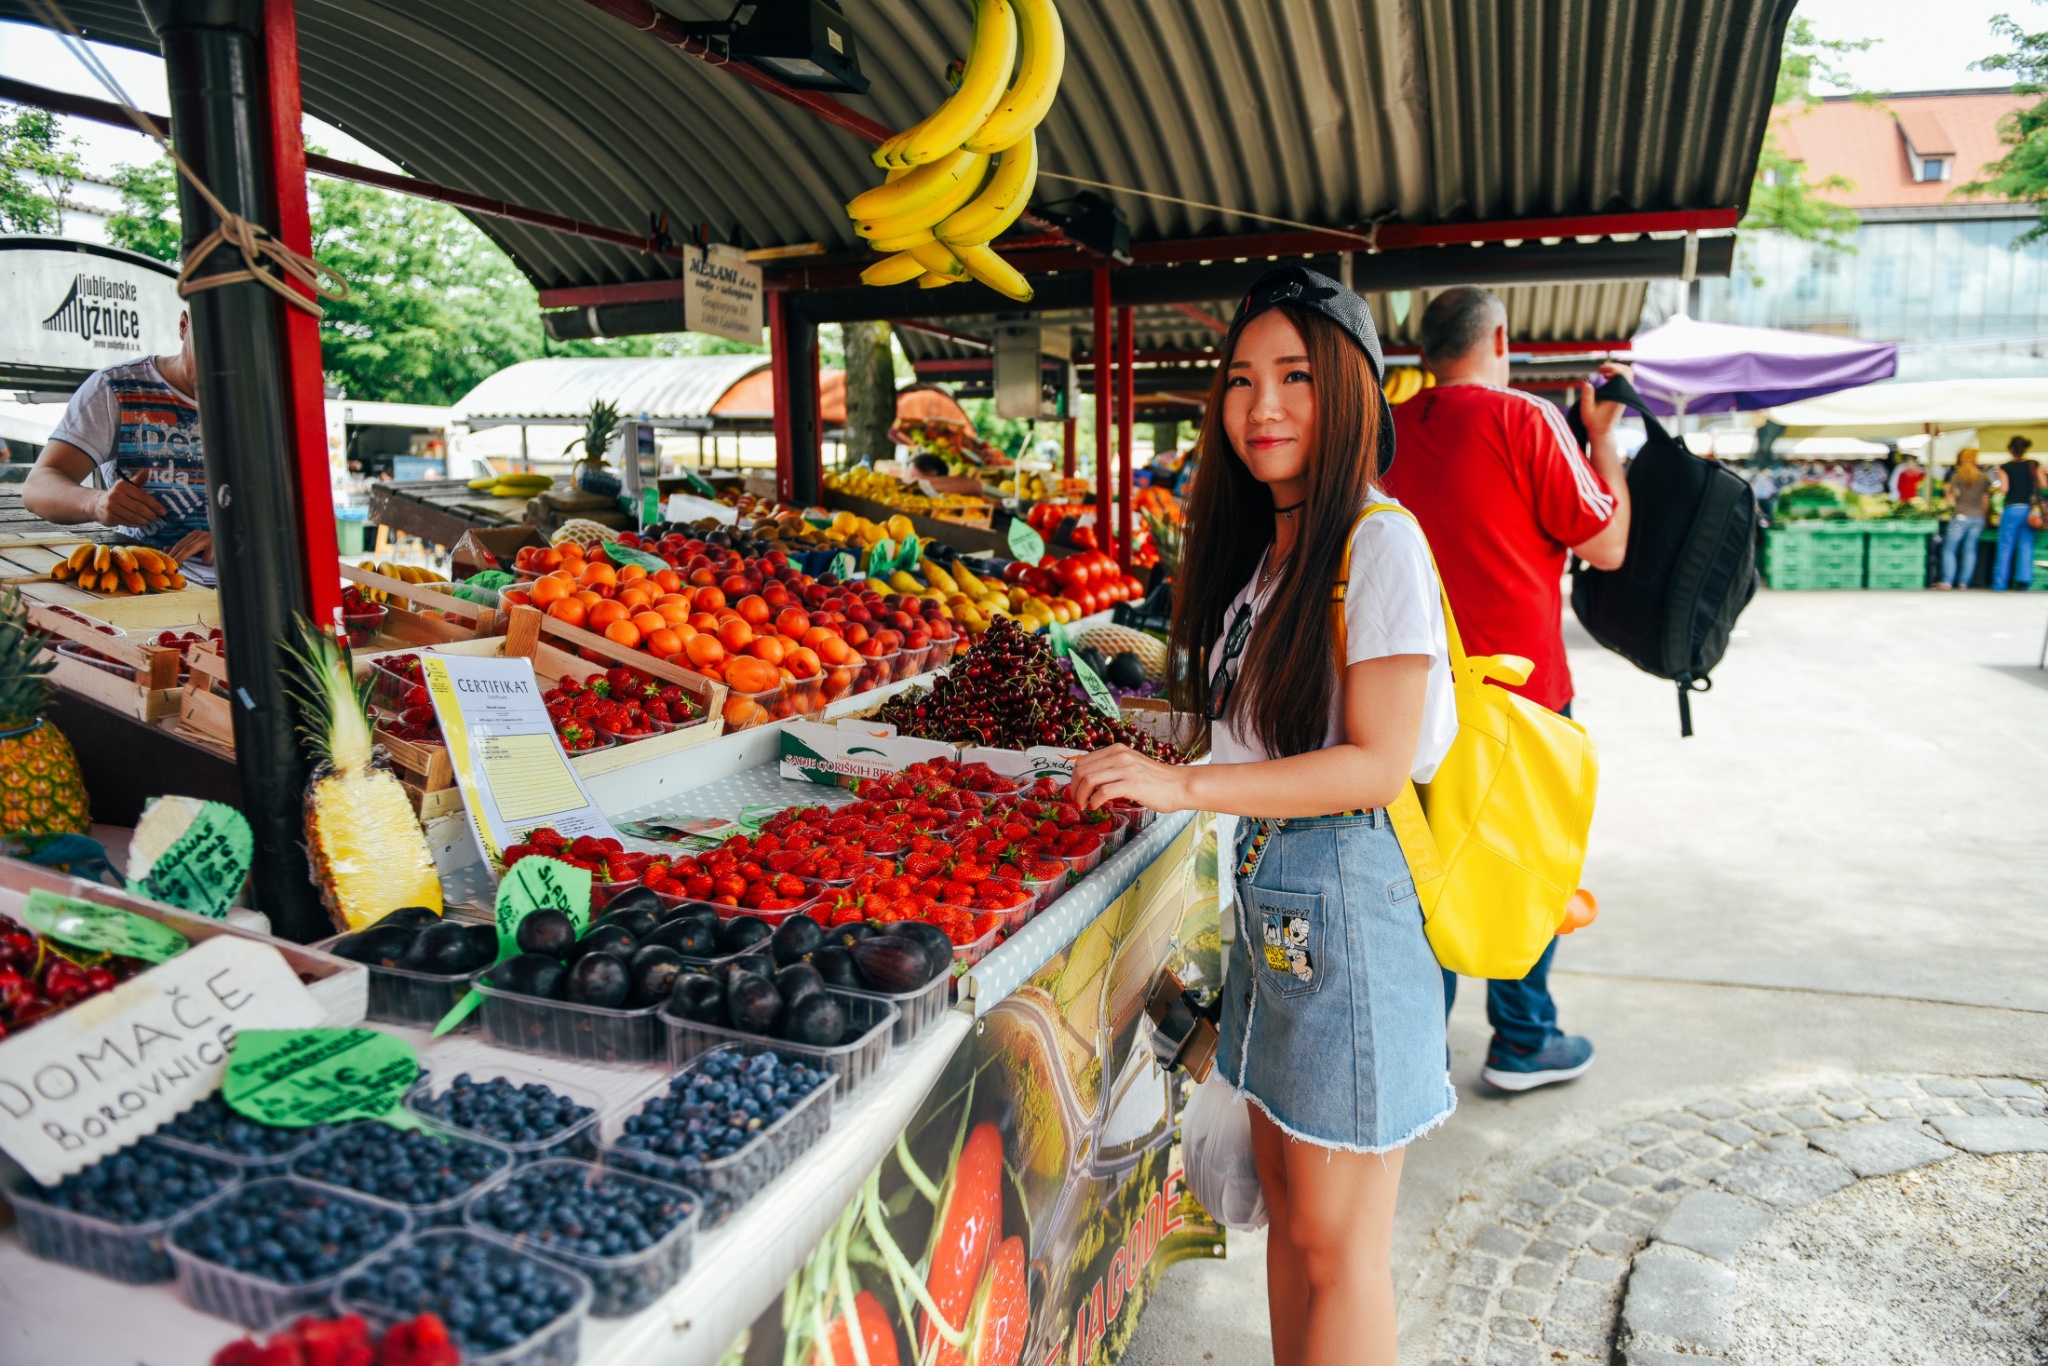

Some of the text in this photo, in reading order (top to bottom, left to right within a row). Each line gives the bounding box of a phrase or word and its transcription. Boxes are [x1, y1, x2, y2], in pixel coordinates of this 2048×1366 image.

[79, 273, 137, 301] ljubljanske
[79, 298, 139, 341] tržnice
[457, 678, 529, 694] CERTIFIKAT
[785, 754, 816, 769] SADJE
[817, 760, 870, 777] GORIŠKIH
[538, 865, 580, 928] SLADKE
[0, 968, 254, 1119] DOMAČE
[42, 1024, 237, 1151] BOROVNICE
